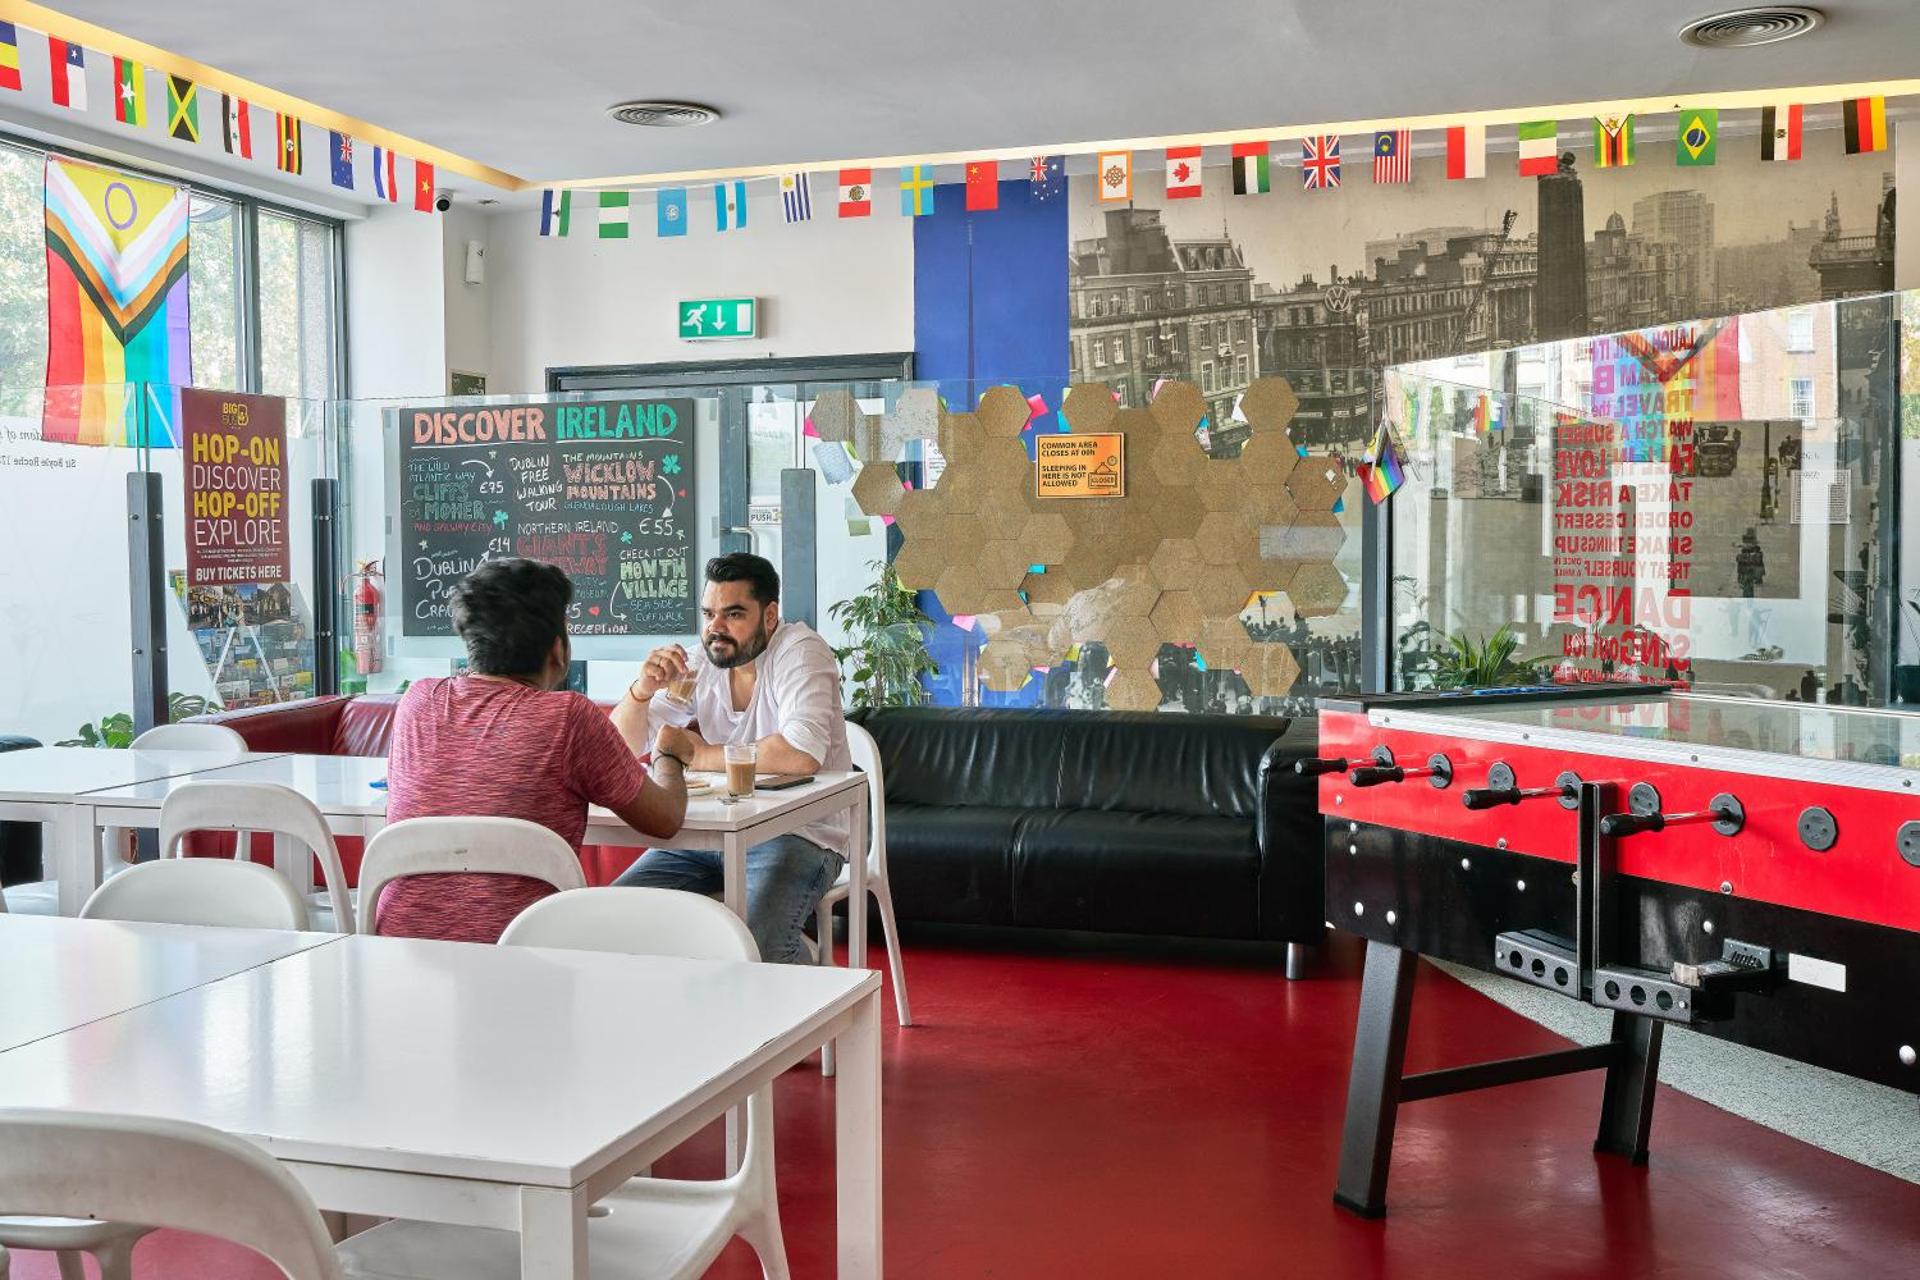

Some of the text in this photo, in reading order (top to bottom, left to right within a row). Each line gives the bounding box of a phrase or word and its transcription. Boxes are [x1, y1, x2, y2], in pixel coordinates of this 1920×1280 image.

[223, 402, 238, 414] BIG
[414, 404, 677, 445] DISCOVER IRELAND
[192, 432, 280, 466] HOP-ON
[562, 450, 644, 462] THE MOUNTAINS
[1042, 449, 1069, 457] CLOSES
[428, 460, 450, 472] WILD
[509, 454, 549, 471] DUBLIN
[1042, 464, 1077, 472] SLEEPING
[193, 464, 281, 490] DISCOVER
[455, 471, 476, 483] WAY
[521, 469, 550, 484] FREE
[562, 460, 656, 483] WICKLOW
[1042, 472, 1060, 480] HERE
[1071, 471, 1087, 479] NOT
[413, 481, 470, 502] CLIFFS
[480, 481, 504, 494] €75
[516, 480, 563, 500] WALKING
[566, 483, 657, 500] MOUNTAINS
[194, 491, 281, 518] HOP-OFF
[424, 500, 486, 520] MOHER
[526, 498, 557, 512] TOUR
[629, 503, 655, 514] LAKES
[750, 514, 771, 522] PUSH
[194, 519, 282, 546] EXPLORE
[517, 520, 619, 536] NORTHERN IRELAND
[640, 518, 674, 536] €55
[488, 537, 510, 553] €14
[620, 546, 689, 560] CHECK IT OUT
[196, 565, 282, 581] BUY TICKETS HERE
[413, 557, 474, 580] DUBLIN
[620, 557, 687, 580] HOWTH
[621, 577, 688, 600] VILLAGE
[566, 623, 628, 635] RECEPTION
